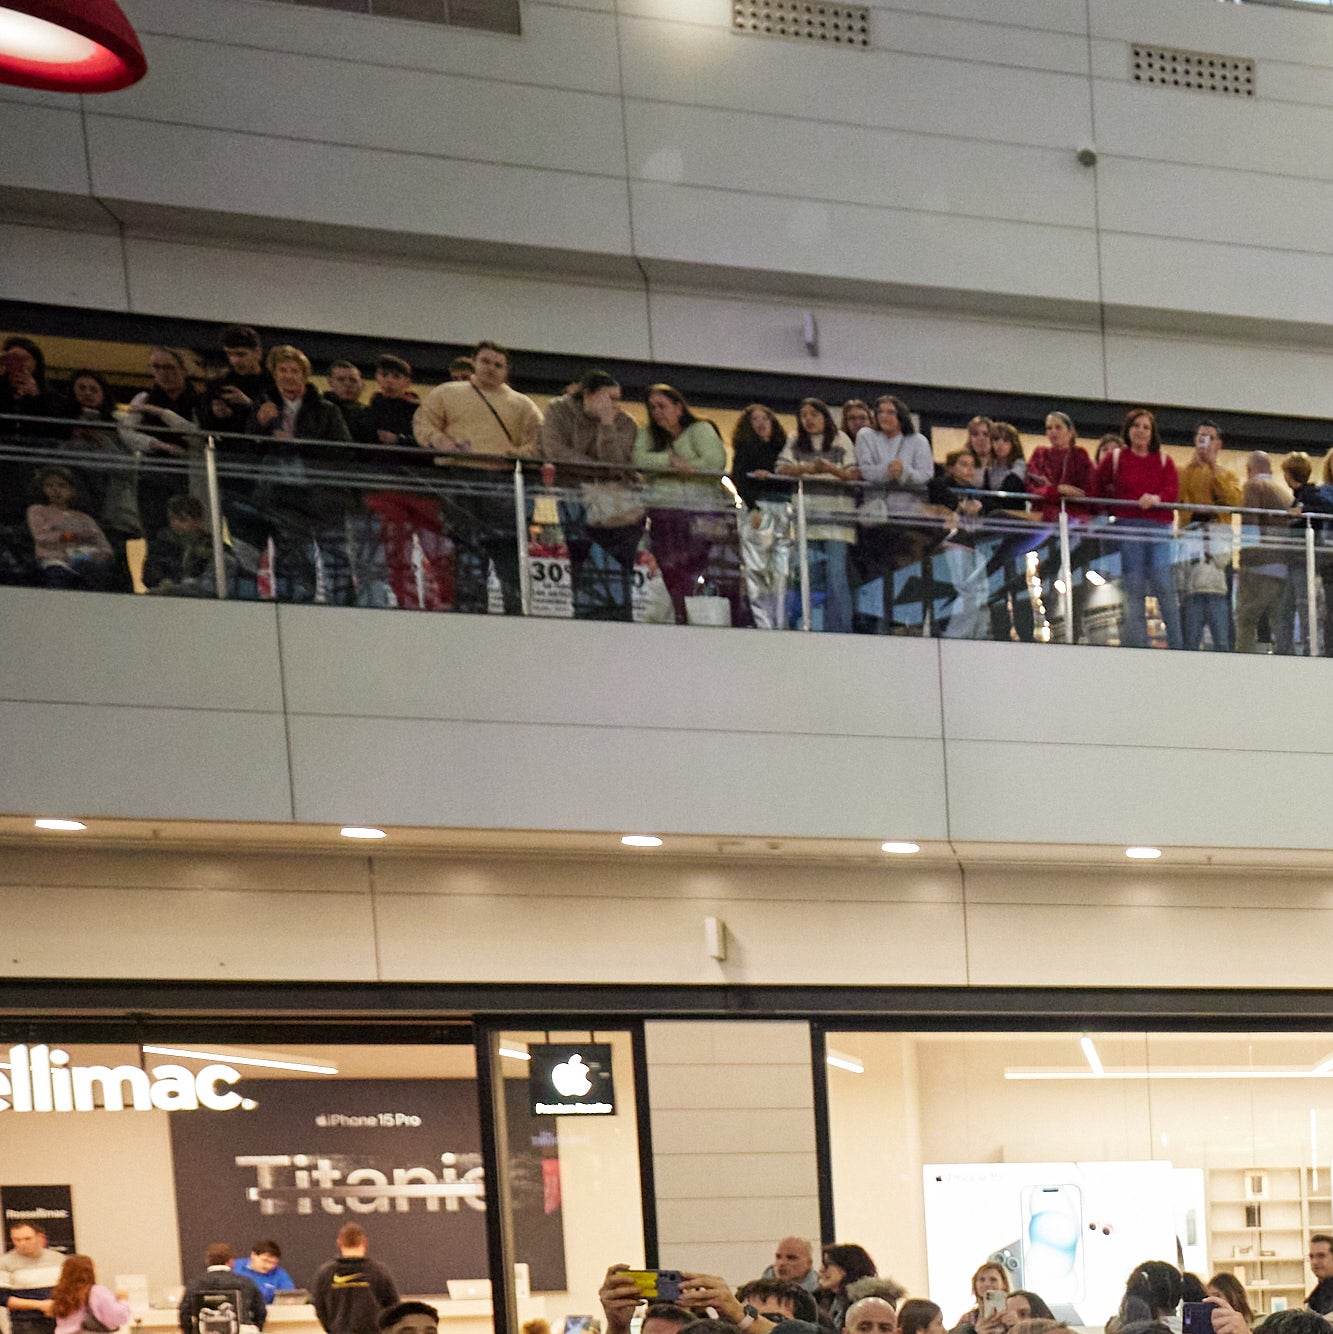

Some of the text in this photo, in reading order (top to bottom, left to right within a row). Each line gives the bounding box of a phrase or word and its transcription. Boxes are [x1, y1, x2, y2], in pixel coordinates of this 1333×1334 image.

[0, 1043, 259, 1112] llimac.
[327, 1112, 422, 1128] iPhone 15 Pro
